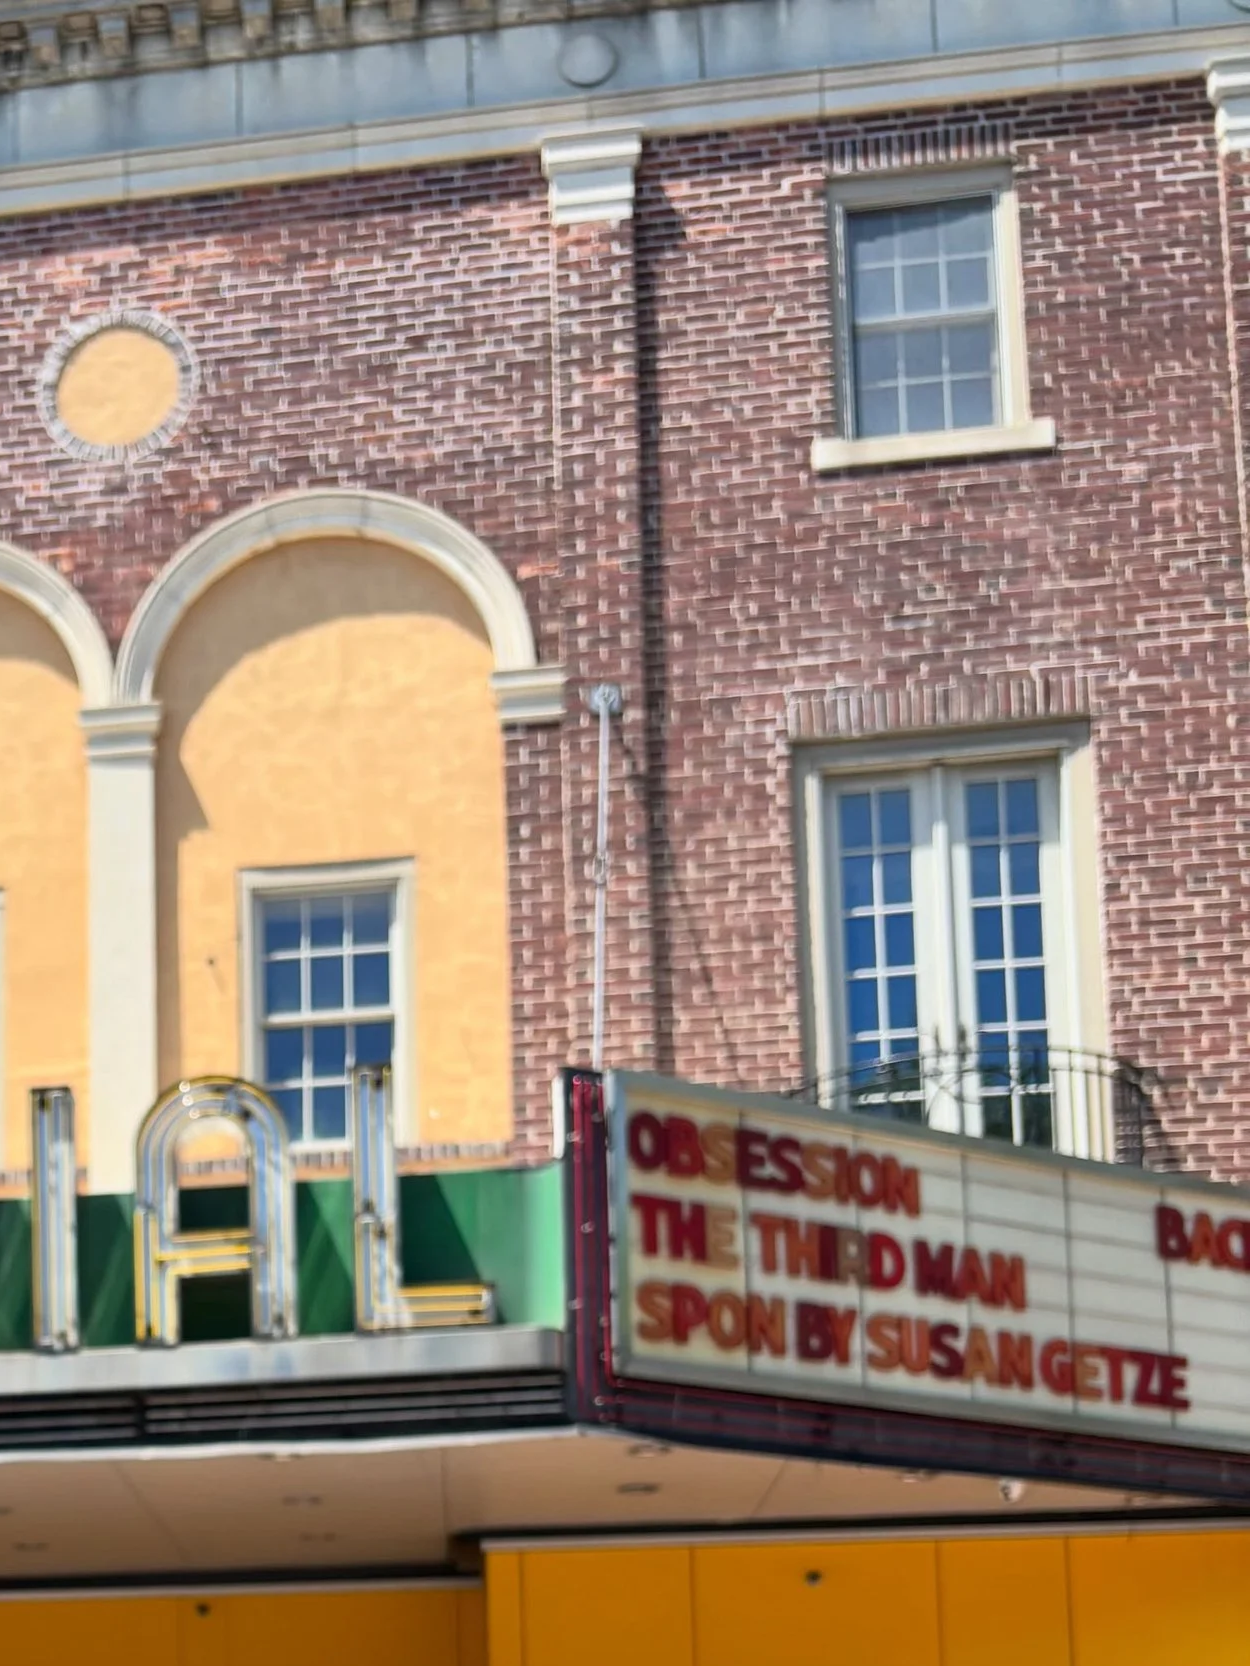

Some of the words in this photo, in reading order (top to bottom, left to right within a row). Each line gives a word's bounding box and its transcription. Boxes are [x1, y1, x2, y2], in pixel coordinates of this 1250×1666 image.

[628, 1111, 921, 1219] OBSESSION
[631, 1193, 740, 1271] THE
[751, 1211, 906, 1292] THIRD
[913, 1239, 1028, 1314] MAN
[1154, 1203, 1250, 1276] BAC
[636, 1278, 788, 1359] SPON
[795, 1302, 858, 1367] BY
[865, 1311, 1035, 1392] SUSAN
[1039, 1337, 1192, 1412] GETZE
